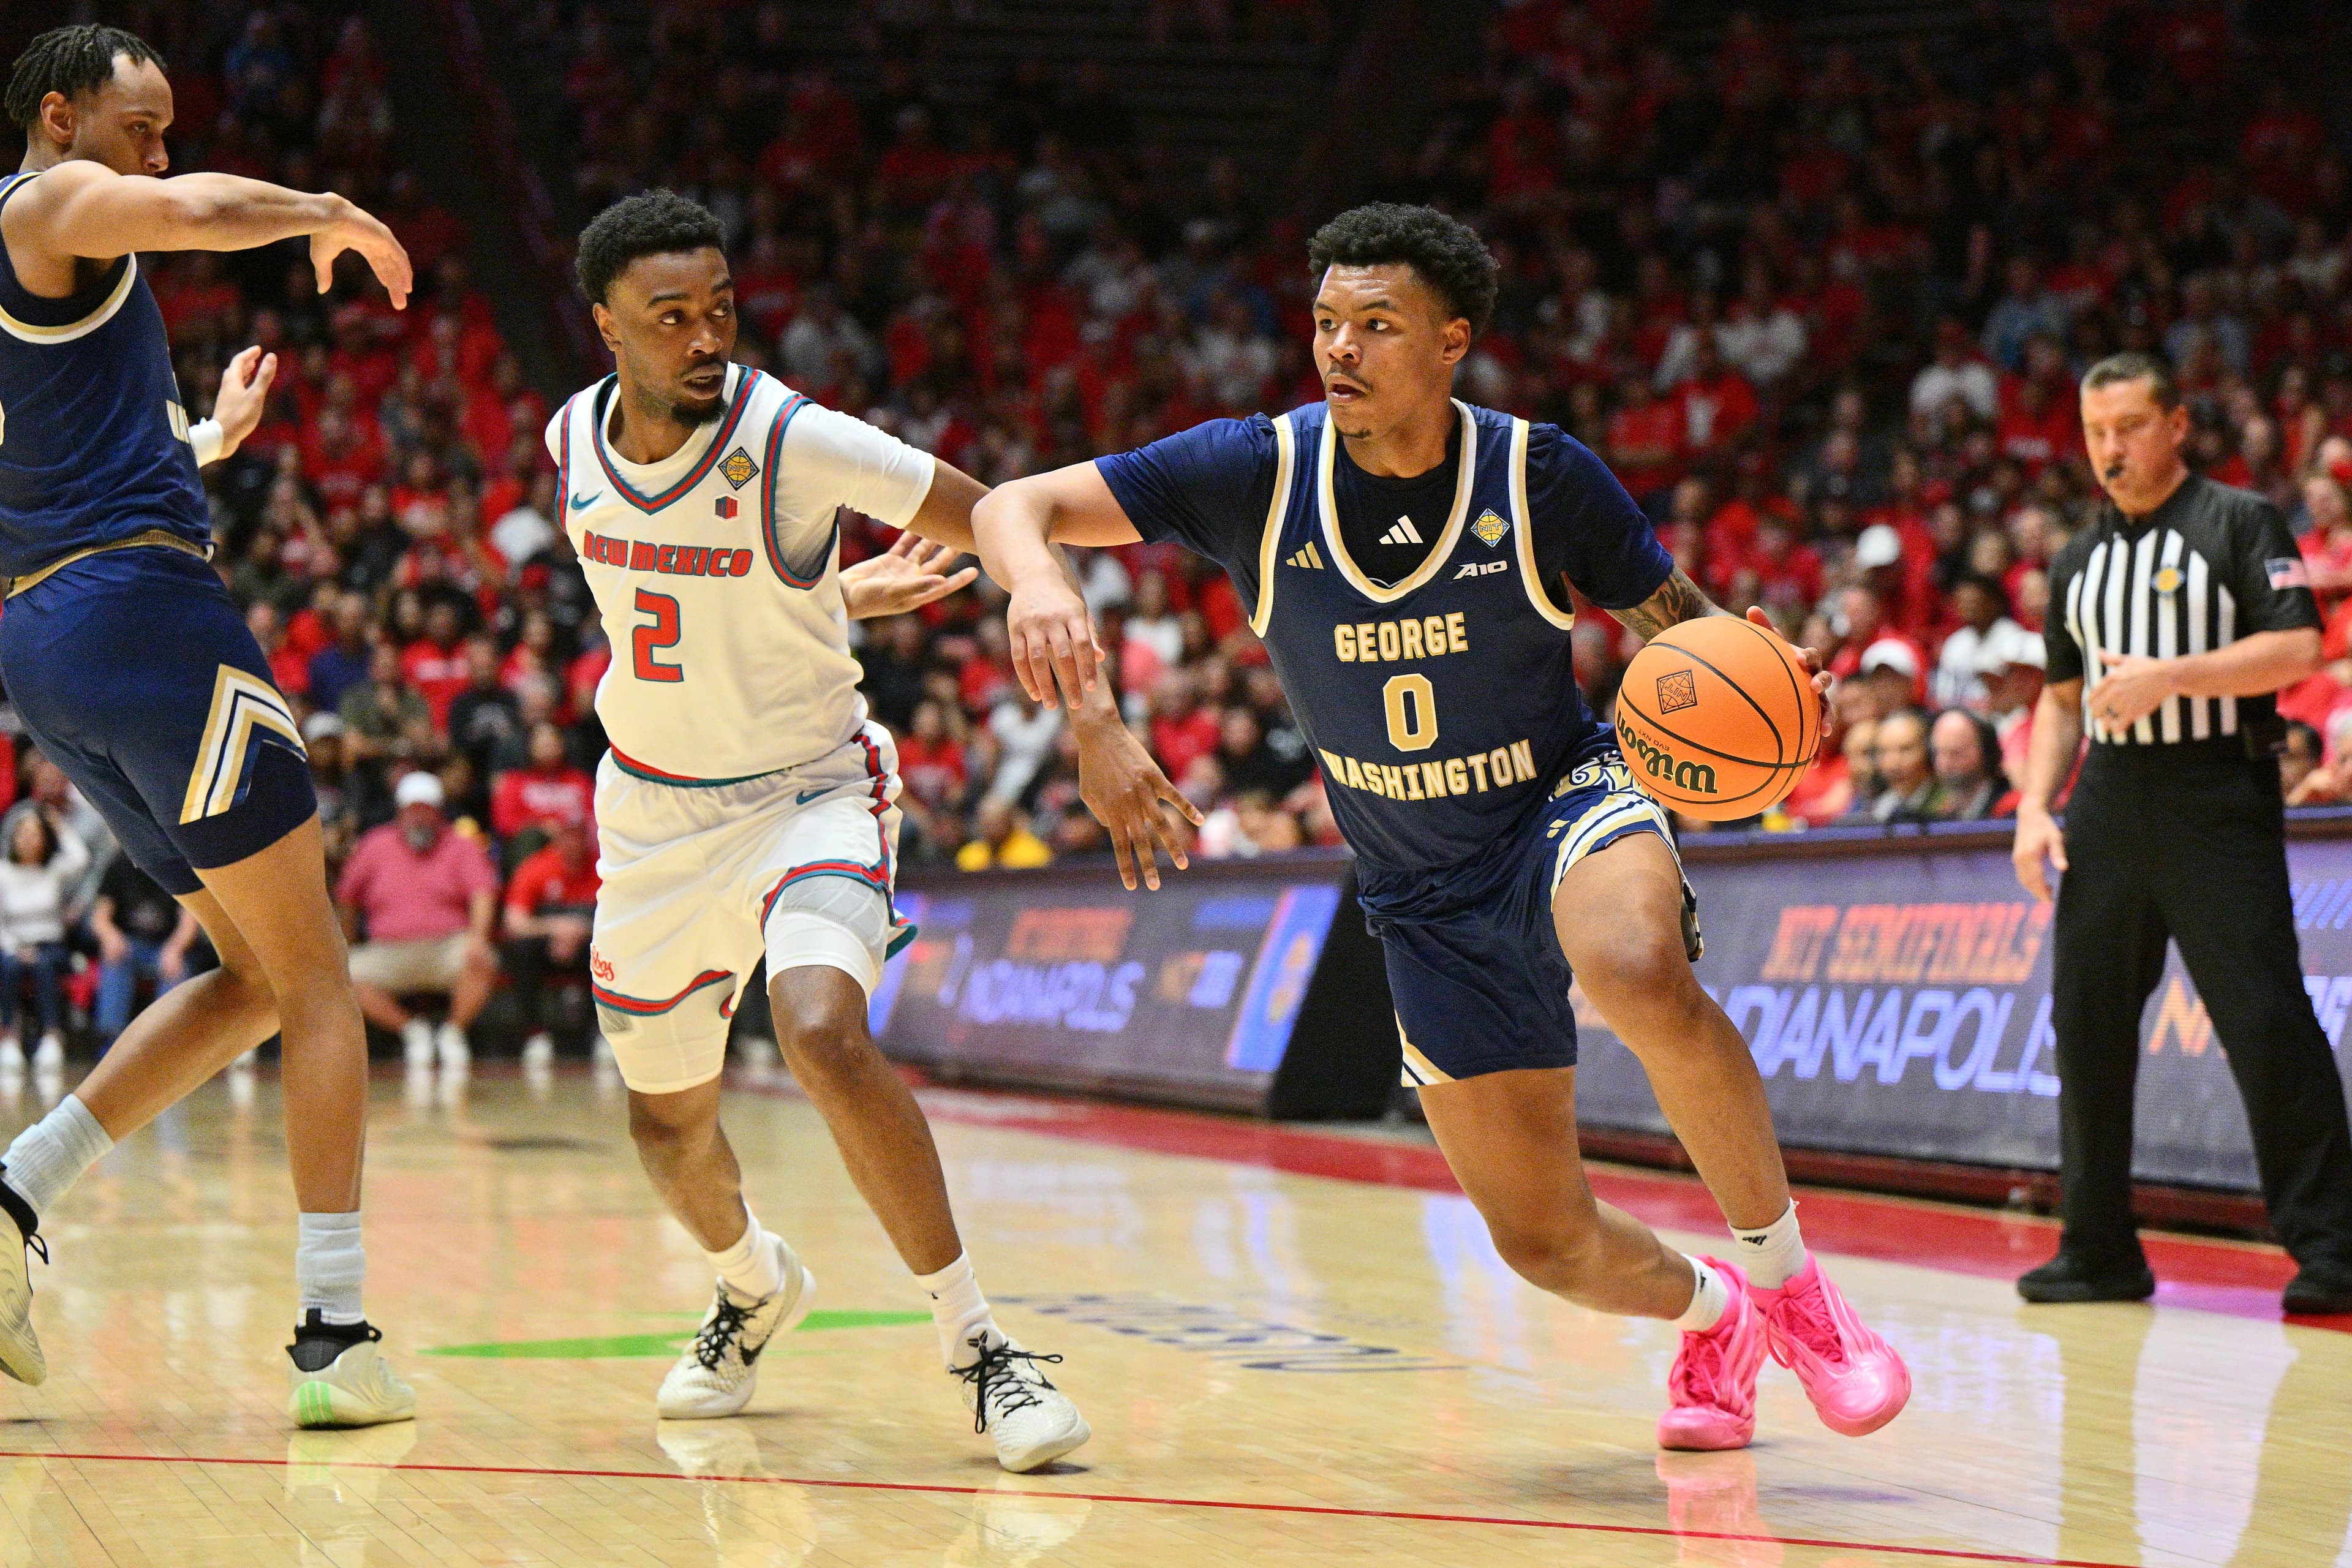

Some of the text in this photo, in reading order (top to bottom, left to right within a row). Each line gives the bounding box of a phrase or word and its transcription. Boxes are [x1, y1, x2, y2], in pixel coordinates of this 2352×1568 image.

[728, 464, 749, 473] NIT
[1479, 523, 1501, 532] NIT
[584, 529, 753, 577] NEW MEXICO
[1452, 560, 1508, 580] A10
[631, 587, 684, 683] 2
[1334, 611, 1469, 663] GEORGE
[1382, 673, 1439, 752] 0
[1665, 684, 1688, 701] NIT
[1617, 707, 1719, 794] Wilson
[1638, 729, 1670, 752] EVO NXT
[1317, 739, 1537, 801] WASHINGTON
